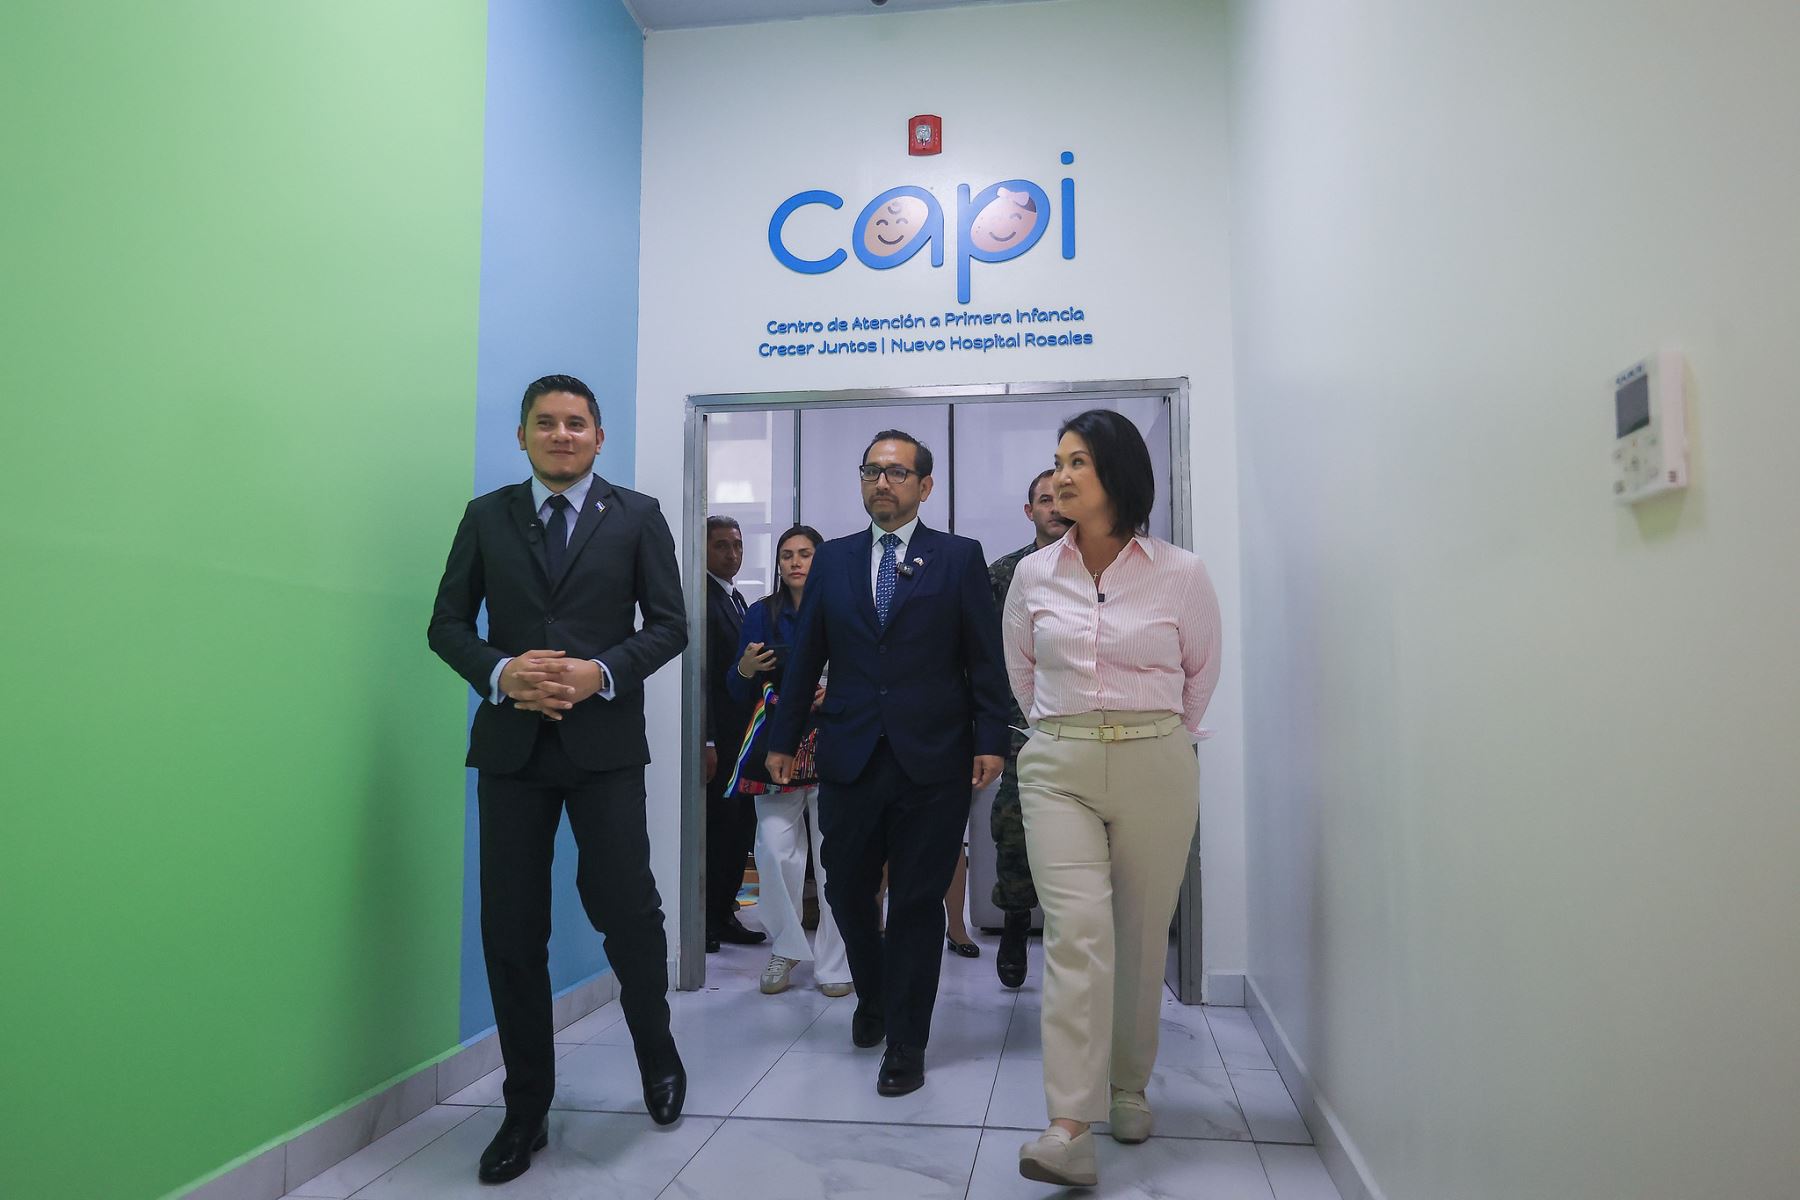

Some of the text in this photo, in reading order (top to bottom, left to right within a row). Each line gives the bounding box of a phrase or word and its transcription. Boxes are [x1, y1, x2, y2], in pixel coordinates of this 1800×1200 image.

[766, 306, 1085, 335] Centro de Atención a Primera Infancia
[758, 342, 815, 357] Crecer
[818, 340, 878, 354] Juntos
[891, 338, 946, 353] Nuevo
[950, 332, 1020, 353] Hospital
[1025, 330, 1093, 347] Rosales
